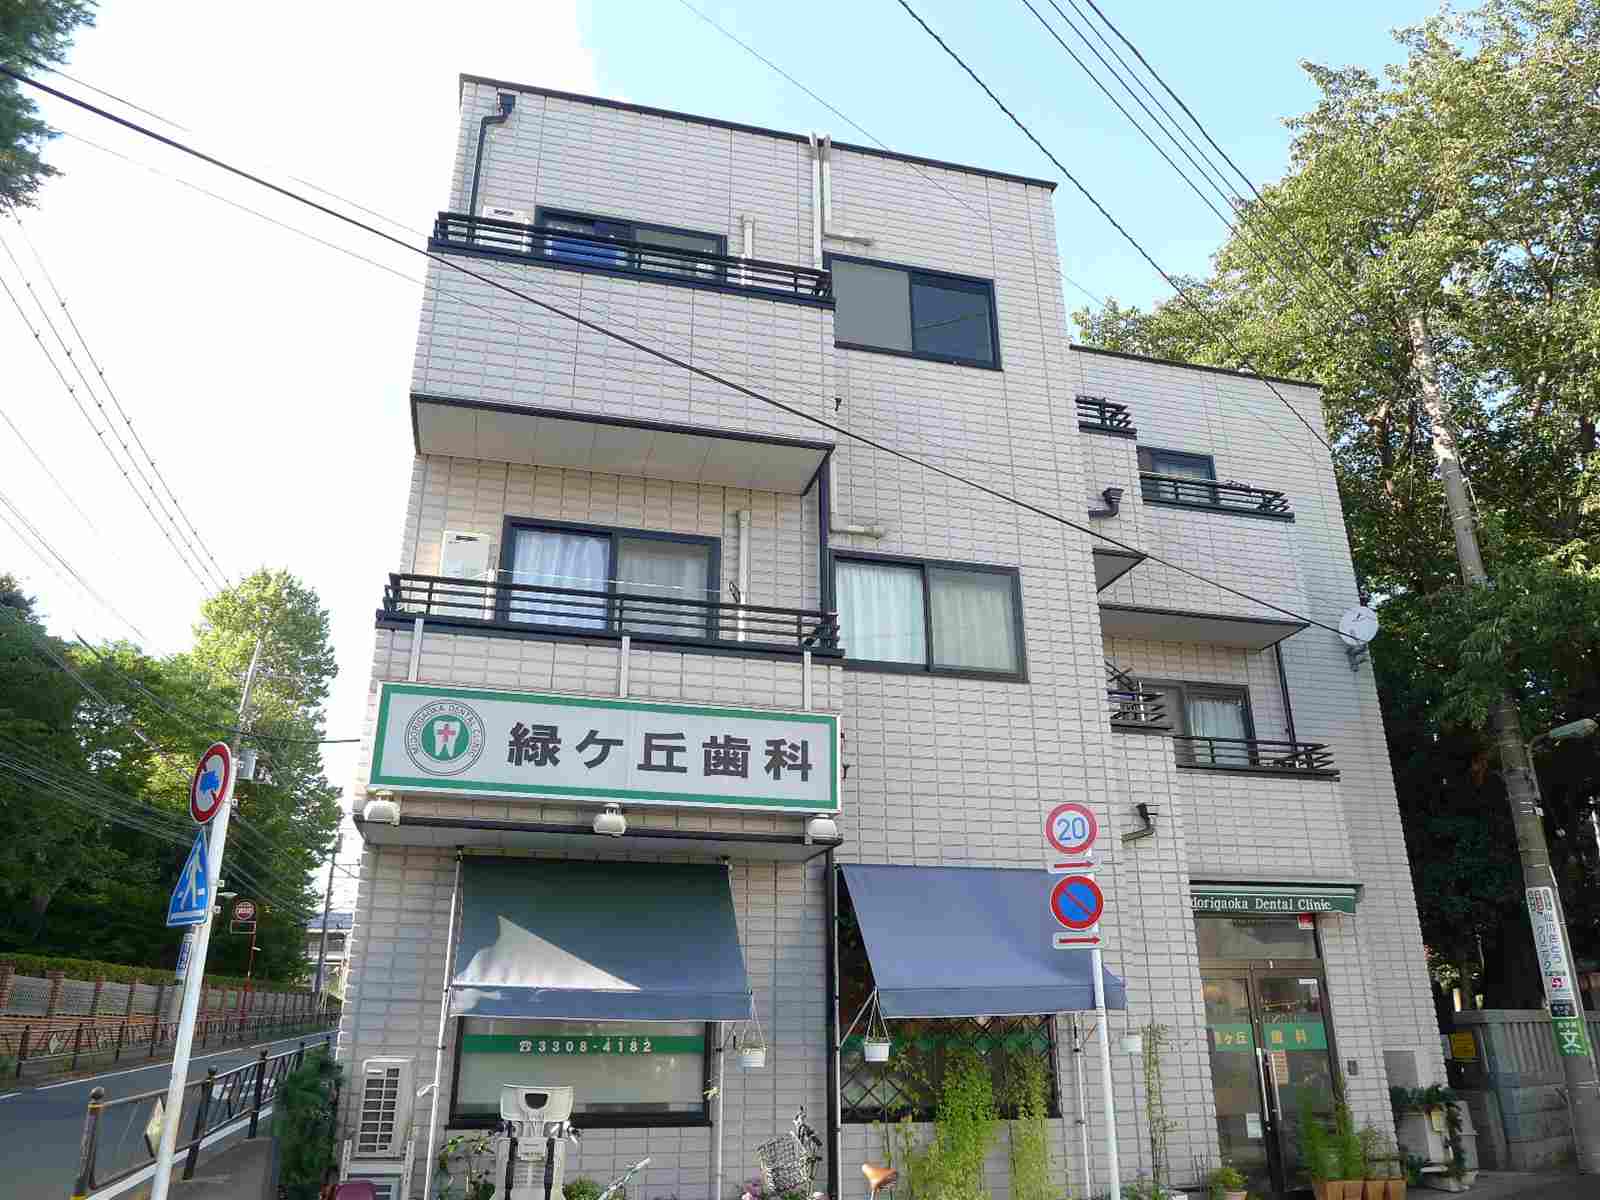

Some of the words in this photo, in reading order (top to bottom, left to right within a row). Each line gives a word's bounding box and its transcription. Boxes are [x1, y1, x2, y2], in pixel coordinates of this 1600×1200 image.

[1056, 816, 1086, 841] 20
[1255, 897, 1293, 911] Dental
[1297, 898, 1332, 912] Clinic
[538, 1039, 652, 1053] 3308-4182
